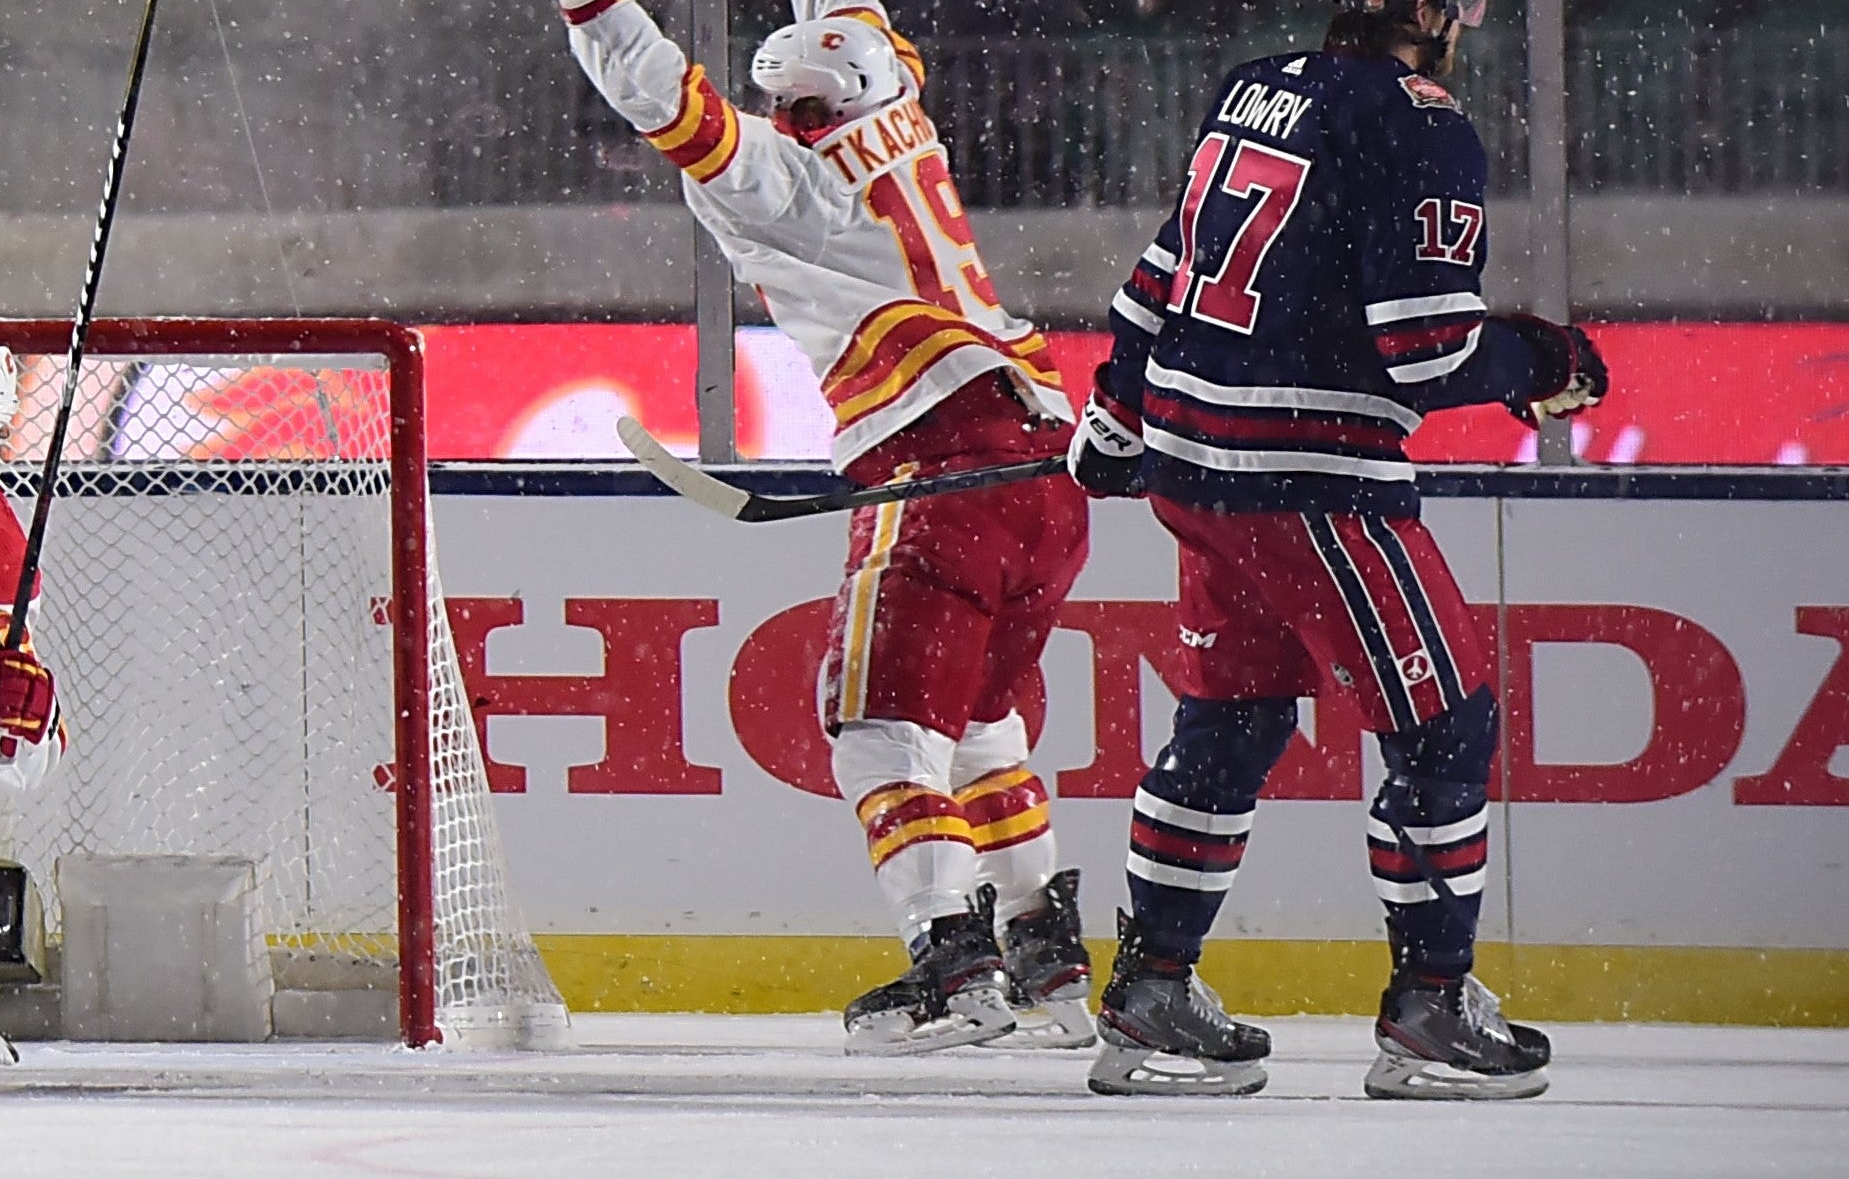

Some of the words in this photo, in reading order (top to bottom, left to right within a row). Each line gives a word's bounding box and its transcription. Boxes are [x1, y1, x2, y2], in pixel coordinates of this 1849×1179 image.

[1217, 79, 1313, 140] LOWRY
[1167, 131, 1312, 335] 17
[1413, 198, 1484, 267] 17
